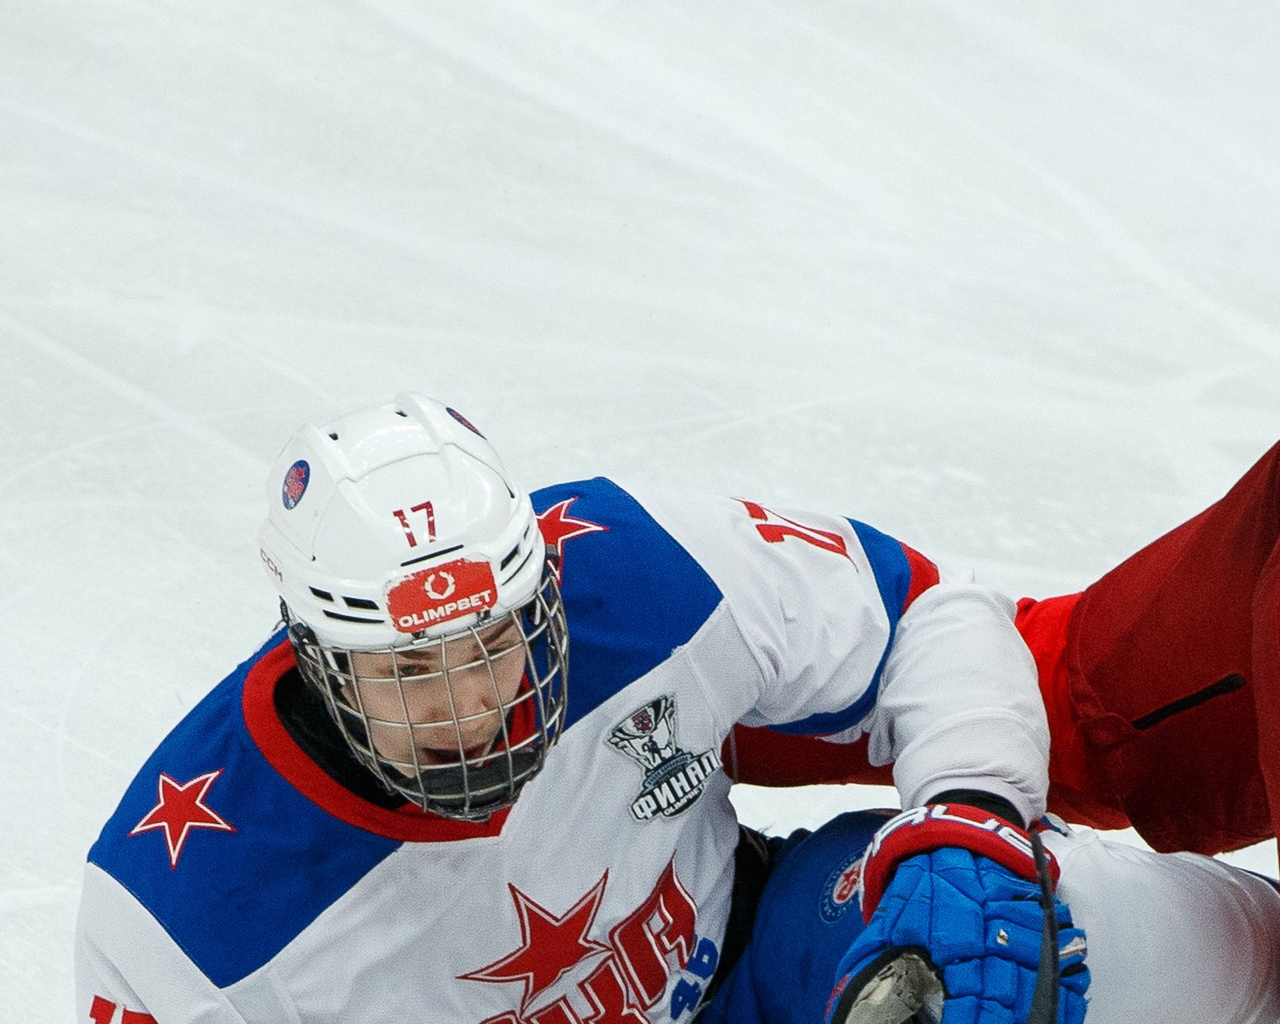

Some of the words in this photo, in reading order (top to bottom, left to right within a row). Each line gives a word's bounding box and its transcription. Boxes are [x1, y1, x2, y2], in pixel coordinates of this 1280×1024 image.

[393, 501, 436, 547] 17
[398, 590, 491, 628] OLIMPBET
[632, 748, 720, 820] ФИНАЛ
[670, 937, 718, 1019] 46
